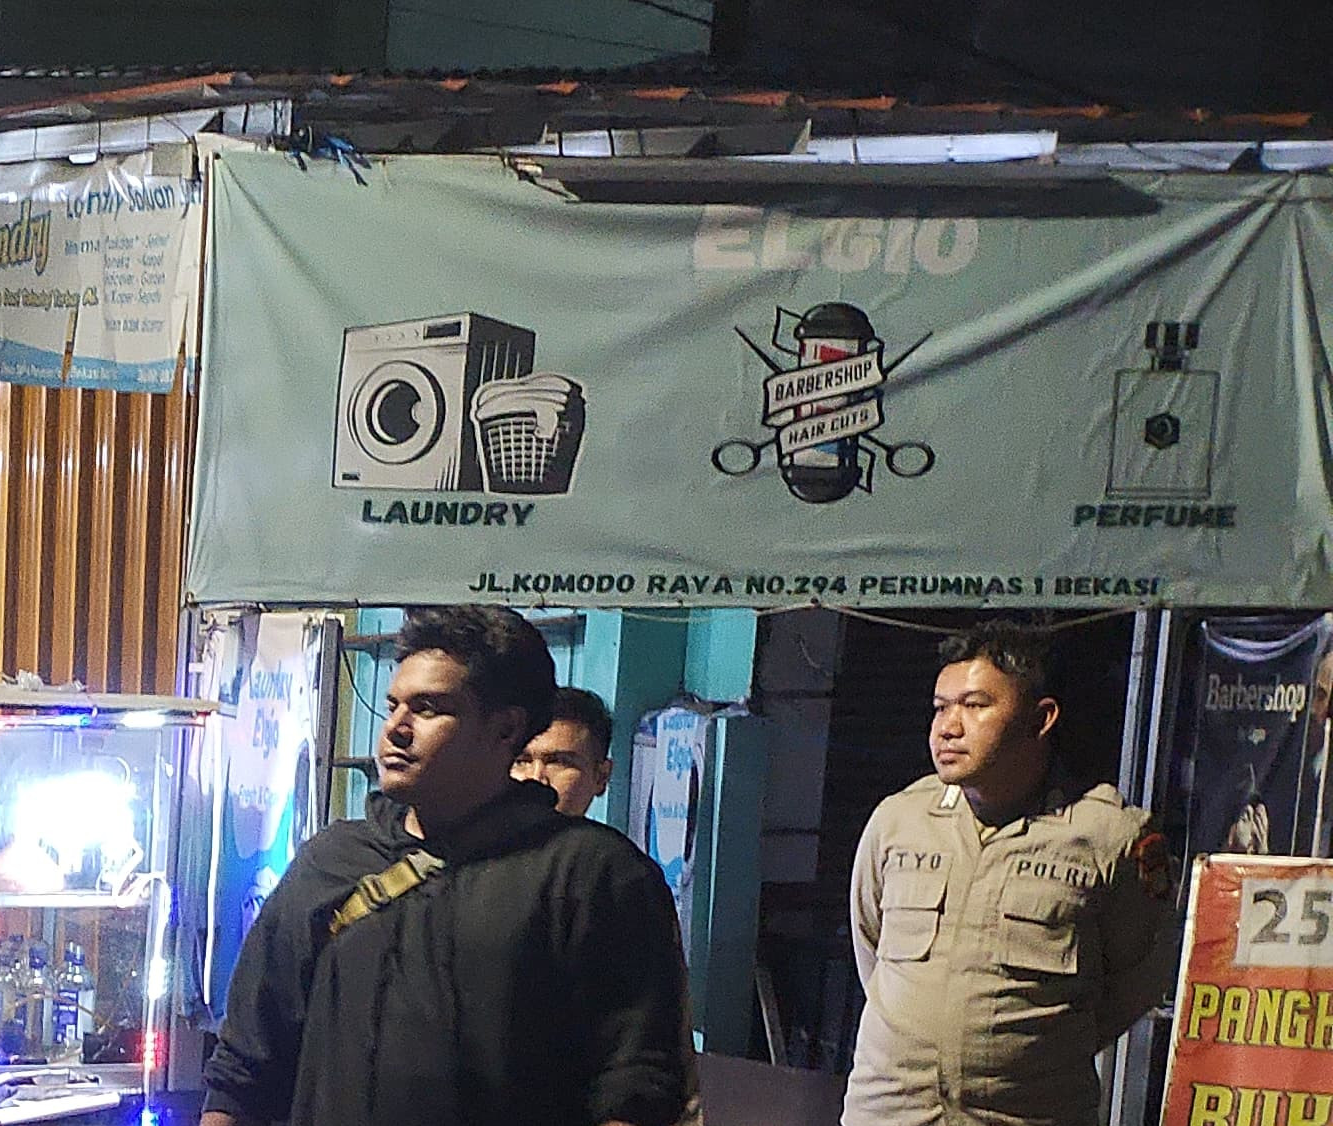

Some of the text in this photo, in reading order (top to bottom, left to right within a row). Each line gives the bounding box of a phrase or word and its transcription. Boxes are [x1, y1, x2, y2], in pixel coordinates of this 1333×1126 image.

[693, 203, 978, 275] ELGIO
[775, 360, 873, 402] BARBERSHOP
[788, 421, 825, 444] HAIR
[362, 500, 1237, 529] LAUNDRY PERFUME
[469, 573, 1160, 596] JL.KOMODO RAYA NO.294 PERUMNAS 1 BEKASI
[1205, 673, 1306, 722] Barbershop
